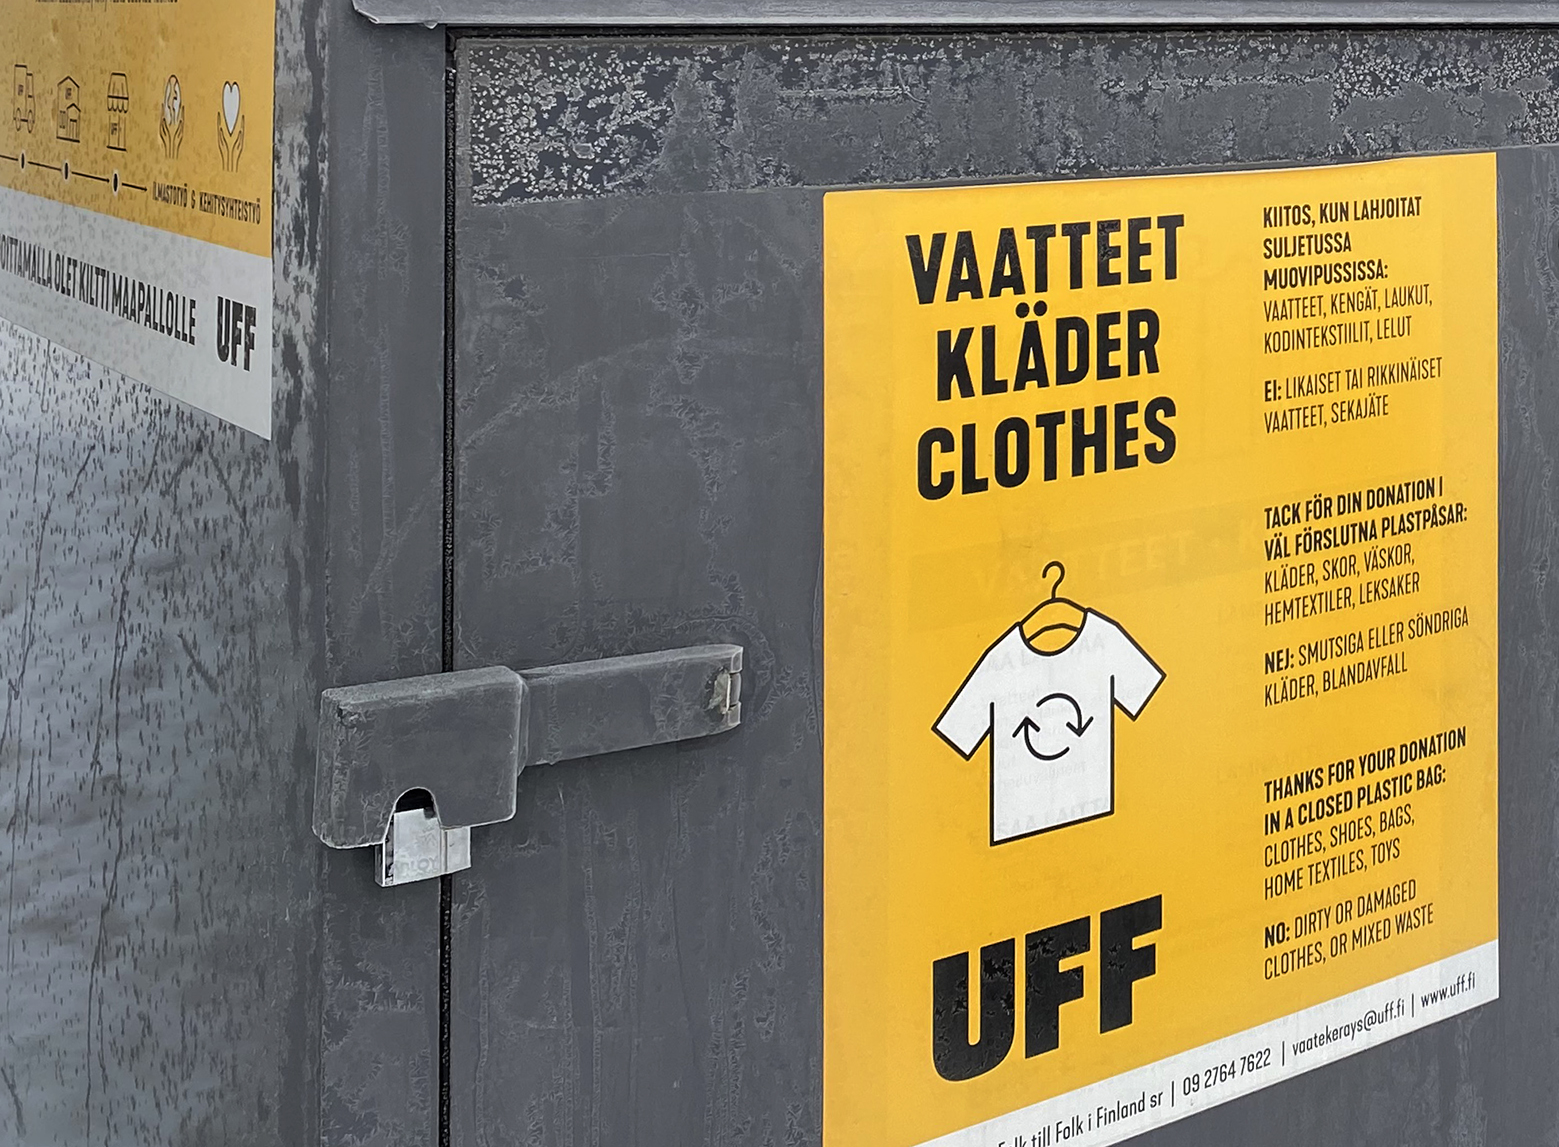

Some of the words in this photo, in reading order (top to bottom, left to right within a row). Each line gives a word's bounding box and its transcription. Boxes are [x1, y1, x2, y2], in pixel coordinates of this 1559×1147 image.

[1262, 203, 1316, 229] KIITOS,
[1318, 200, 1349, 225] KUN
[1353, 195, 1422, 221] LAHJOITAT
[906, 214, 1184, 304] VAATTEET
[1262, 231, 1352, 260] SULJETUSSA
[1263, 258, 1388, 291] MUOVIPUSSISSA:
[54, 252, 78, 299] OLET
[79, 261, 109, 312] KILTTI
[112, 271, 196, 346] MAAPALLOLLE
[1262, 294, 1327, 323] VAATTEET,
[1330, 285, 1381, 315] KENGÄT,
[1384, 282, 1433, 309] LAUKUT,
[216, 295, 257, 373] UFF
[936, 301, 1160, 401] KLÄDER
[1263, 319, 1373, 354] KODINTEKSTIILIT,
[1376, 314, 1412, 340] LELUT
[1263, 378, 1282, 403] EI:
[1285, 370, 1342, 400] LIKAISET
[1344, 367, 1363, 391] TAI
[1366, 356, 1442, 388] RIKKINÄISET
[1263, 403, 1328, 434] VAATTEET,
[1330, 392, 1389, 424] SEKAJÄTE
[916, 396, 1176, 500] CLOTHES
[1263, 501, 1302, 530] TACK
[1304, 492, 1333, 523] FÖR
[1336, 490, 1362, 517] DIN
[1365, 476, 1435, 511] DONATION
[1438, 475, 1443, 498] I
[1263, 531, 1291, 562] VÄL
[1294, 518, 1378, 556] FÖRSLUTNA
[1380, 501, 1468, 539] PLASTPÅSAR:
[1264, 562, 1319, 594] KLÄDER,
[1321, 553, 1361, 582] SKOR,
[1362, 542, 1415, 573] VÄSKOR,
[1264, 585, 1356, 626] HEMTEXTILER,
[1358, 571, 1420, 605] LEKSAKER
[1263, 647, 1295, 675] NEJ:
[1298, 630, 1365, 667] SMUTSIGA
[1367, 620, 1404, 650] ELLER
[1407, 605, 1469, 640] SÖNDRIGA
[1264, 673, 1319, 707] KLÄDER,
[1322, 650, 1408, 693] BLANDAVFALL
[1263, 766, 1324, 804] THANKS
[1327, 757, 1355, 786] FOR
[1357, 746, 1396, 777] YOUR
[1398, 725, 1467, 766] DONATION
[1263, 809, 1281, 836] IN
[1283, 806, 1295, 831] A
[1297, 789, 1354, 826] CLOSED
[1356, 771, 1413, 809] PLASTIC
[1415, 763, 1447, 791] BAG:
[1263, 829, 1327, 868] CLOTHES,
[1329, 814, 1376, 848] SHOES,
[1379, 802, 1415, 833] BAGS,
[1263, 866, 1304, 901] HOME
[1307, 848, 1368, 887] TEXTILES,
[1370, 836, 1401, 867] TOYS
[1263, 920, 1291, 949] NO:
[1294, 905, 1332, 940] DIRTY
[1334, 899, 1353, 925] OR
[1356, 878, 1416, 918] DAMAGED
[1264, 940, 1327, 980] CLOTHES,
[1329, 931, 1348, 958] OR
[1351, 917, 1391, 951] MIXED
[1394, 901, 1434, 935] WASTE
[931, 896, 1162, 1081] UFF
[1030, 1124, 1051, 1147] till
[1055, 1114, 1084, 1144] Folk
[1096, 1090, 1145, 1128] Finland
[1149, 1091, 1164, 1109] sr
[1182, 1072, 1200, 1096] 09
[1203, 1059, 1236, 1089] 2764
[1239, 1047, 1271, 1076] 7622
[1292, 998, 1405, 1056] vaatekerays@uff.fi
[1420, 970, 1476, 1008] www.uff.fi
